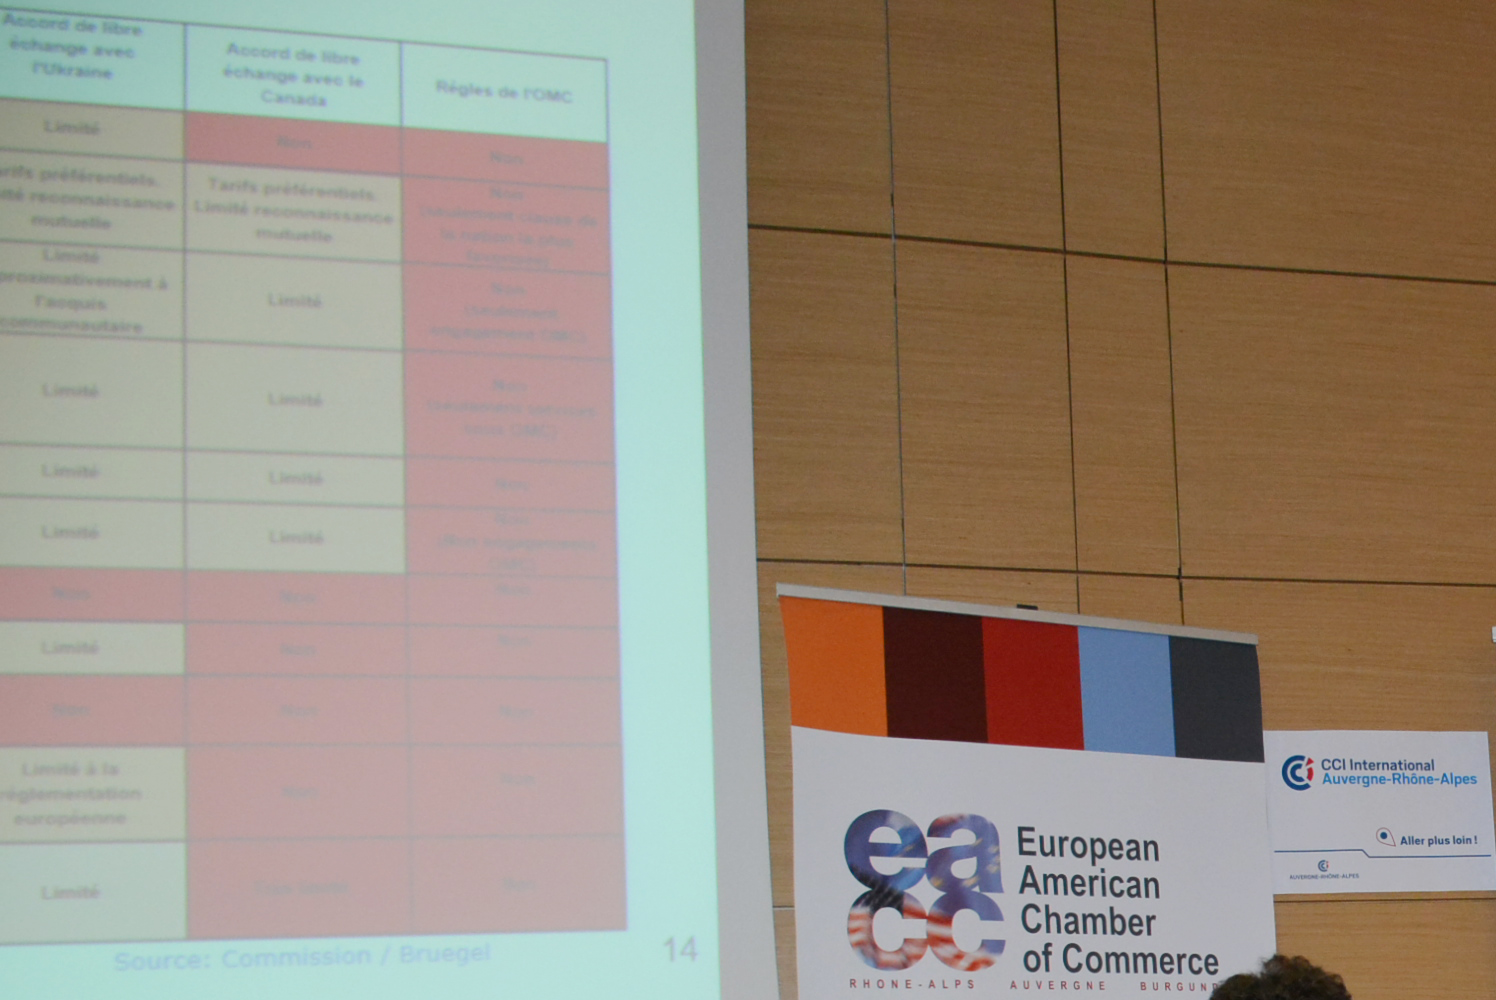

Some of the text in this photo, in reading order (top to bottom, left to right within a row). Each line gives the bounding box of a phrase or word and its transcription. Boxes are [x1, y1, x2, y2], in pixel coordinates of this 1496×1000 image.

[226, 42, 361, 67] Accord de libre
[1321, 758, 1435, 772] CCI International
[1321, 772, 1478, 788] Auvergne-Rhône-Alpes
[1017, 826, 1161, 866] European
[1400, 835, 1426, 846] Aller
[1427, 835, 1452, 848] plus
[1452, 834, 1473, 845] loin
[1018, 865, 1161, 899] American
[1020, 903, 1157, 936] Chamber
[113, 951, 210, 972] Source:
[221, 945, 372, 970] Commission
[400, 943, 492, 970] Bruegel
[661, 934, 699, 963] 14
[1023, 942, 1219, 975] of Commerce
[849, 978, 1218, 992] RHONE-ALPS AUVERGNE BURGUND
